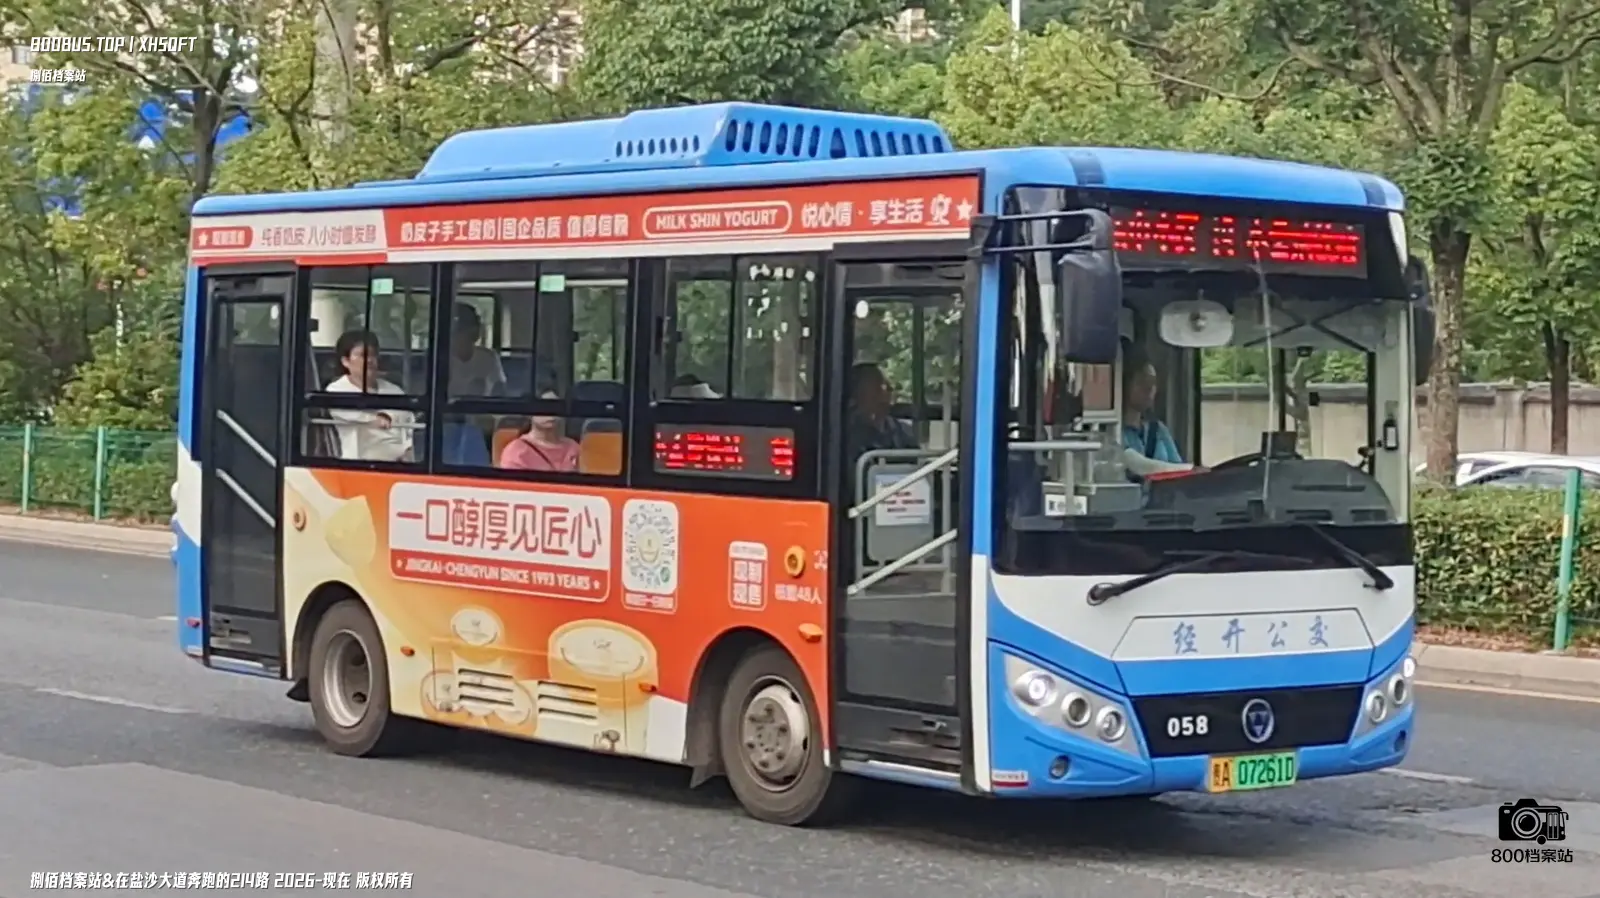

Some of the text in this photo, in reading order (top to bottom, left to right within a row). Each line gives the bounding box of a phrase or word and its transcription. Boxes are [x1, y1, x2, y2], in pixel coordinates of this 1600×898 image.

[655, 208, 778, 231] MILK SHIN YOGURT
[395, 497, 603, 560] 一口醇厚见匠心
[500, 566, 530, 586] SINCE
[531, 570, 556, 588] 1993
[556, 573, 591, 591] YEARS
[1172, 614, 1329, 654] 经开公交
[1166, 714, 1209, 738] 058
[1238, 756, 1295, 786] 07261D
